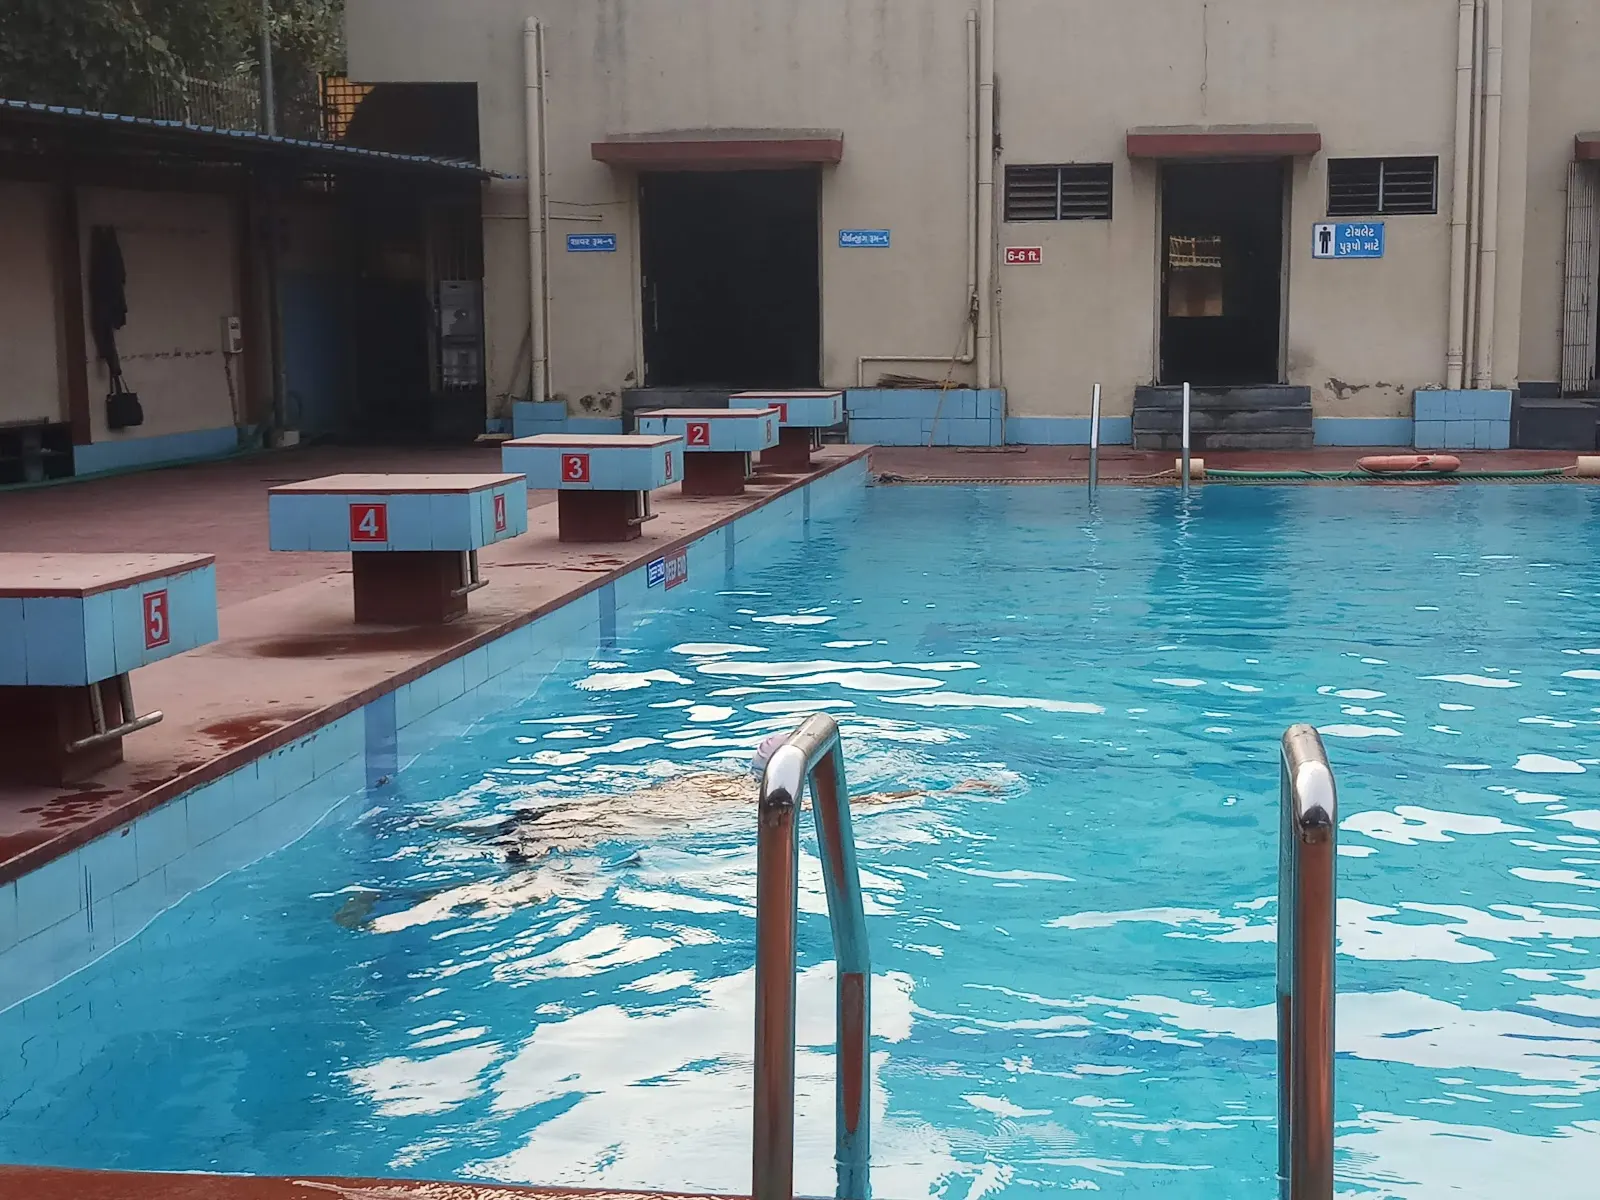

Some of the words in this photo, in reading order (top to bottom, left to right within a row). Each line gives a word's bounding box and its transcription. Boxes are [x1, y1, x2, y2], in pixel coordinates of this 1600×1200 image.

[1345, 225, 1375, 237] ટોયલેટ
[1364, 239, 1380, 251] માટે
[1008, 251, 1025, 261] 6-6
[1027, 251, 1040, 261] ft.
[692, 425, 705, 443] 2
[569, 457, 582, 479] 3
[359, 508, 379, 537] 4
[496, 499, 505, 527] 4
[151, 597, 163, 640] 5
